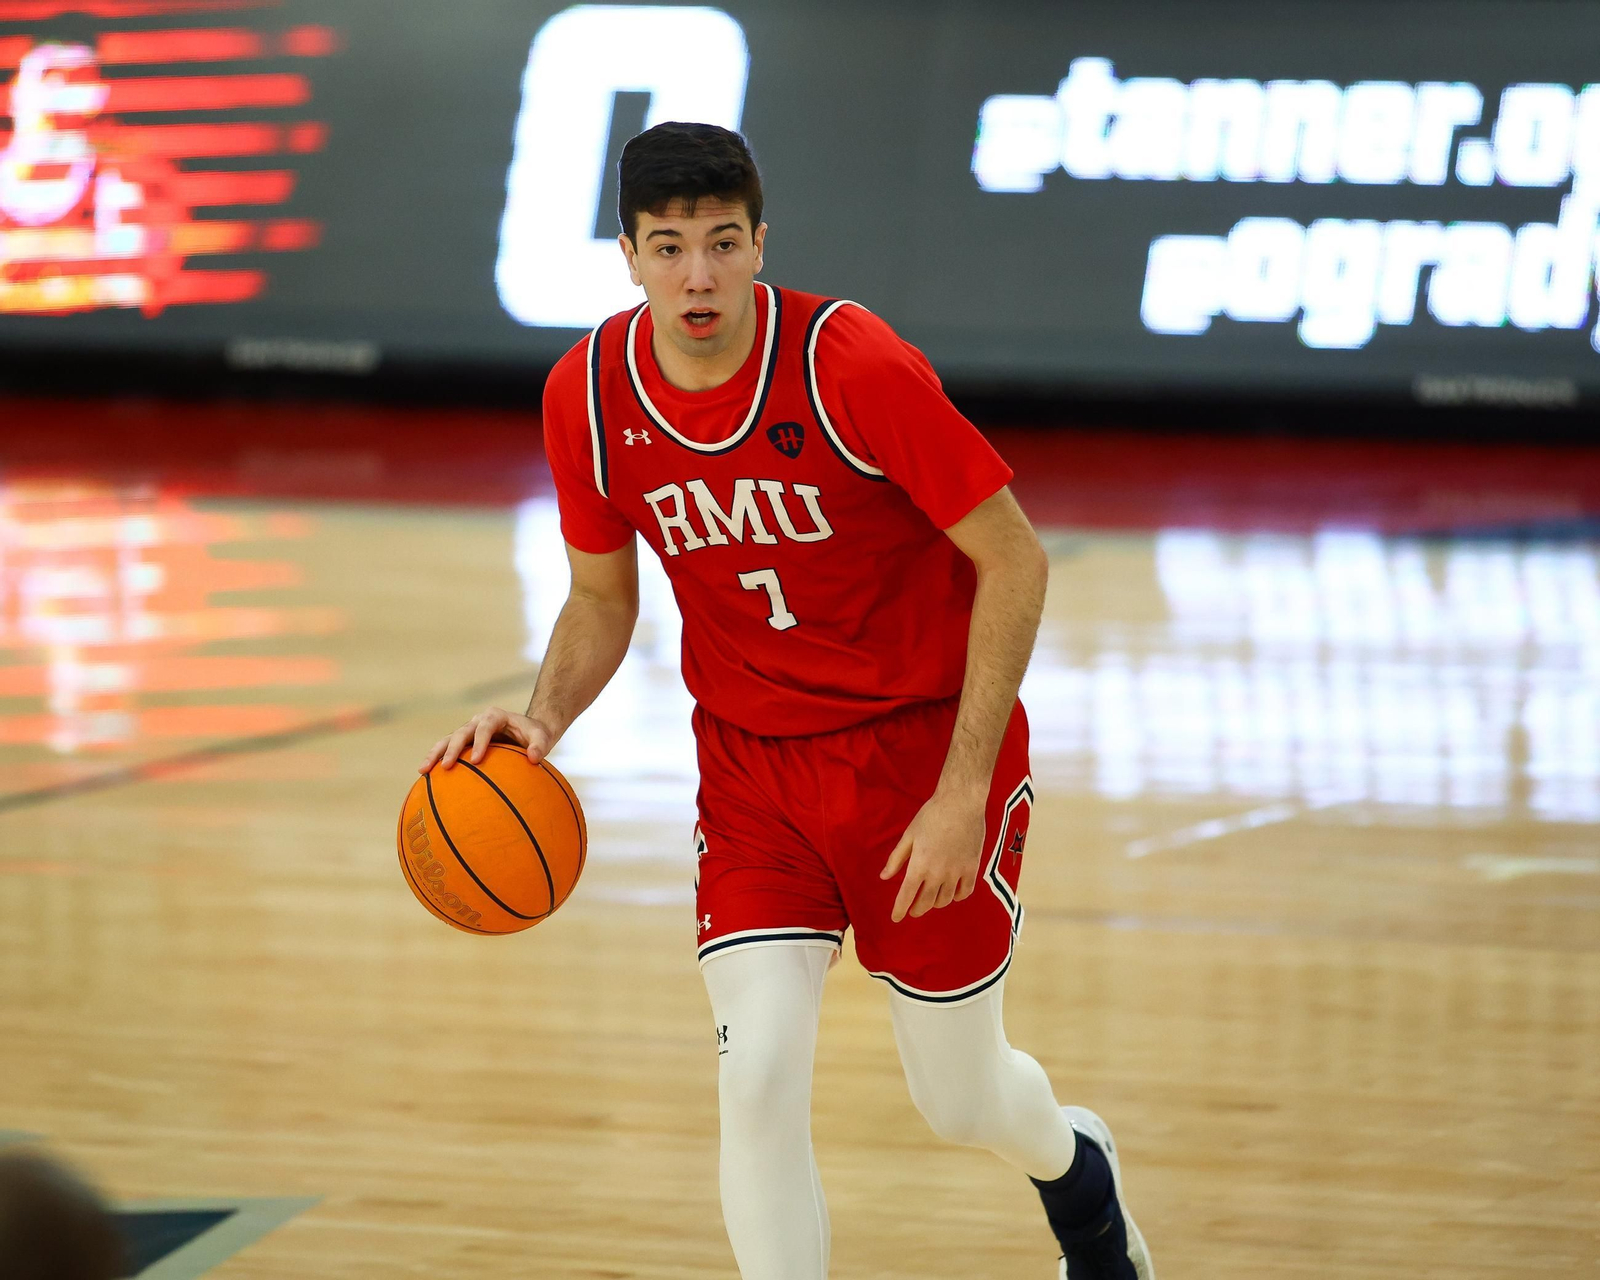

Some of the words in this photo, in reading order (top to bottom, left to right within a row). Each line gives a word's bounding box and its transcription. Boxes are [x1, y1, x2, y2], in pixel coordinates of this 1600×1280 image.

[1141, 193, 1600, 353] @ograd
[642, 478, 834, 556] RMU
[737, 568, 798, 631] 7
[406, 807, 482, 926] Wilson
